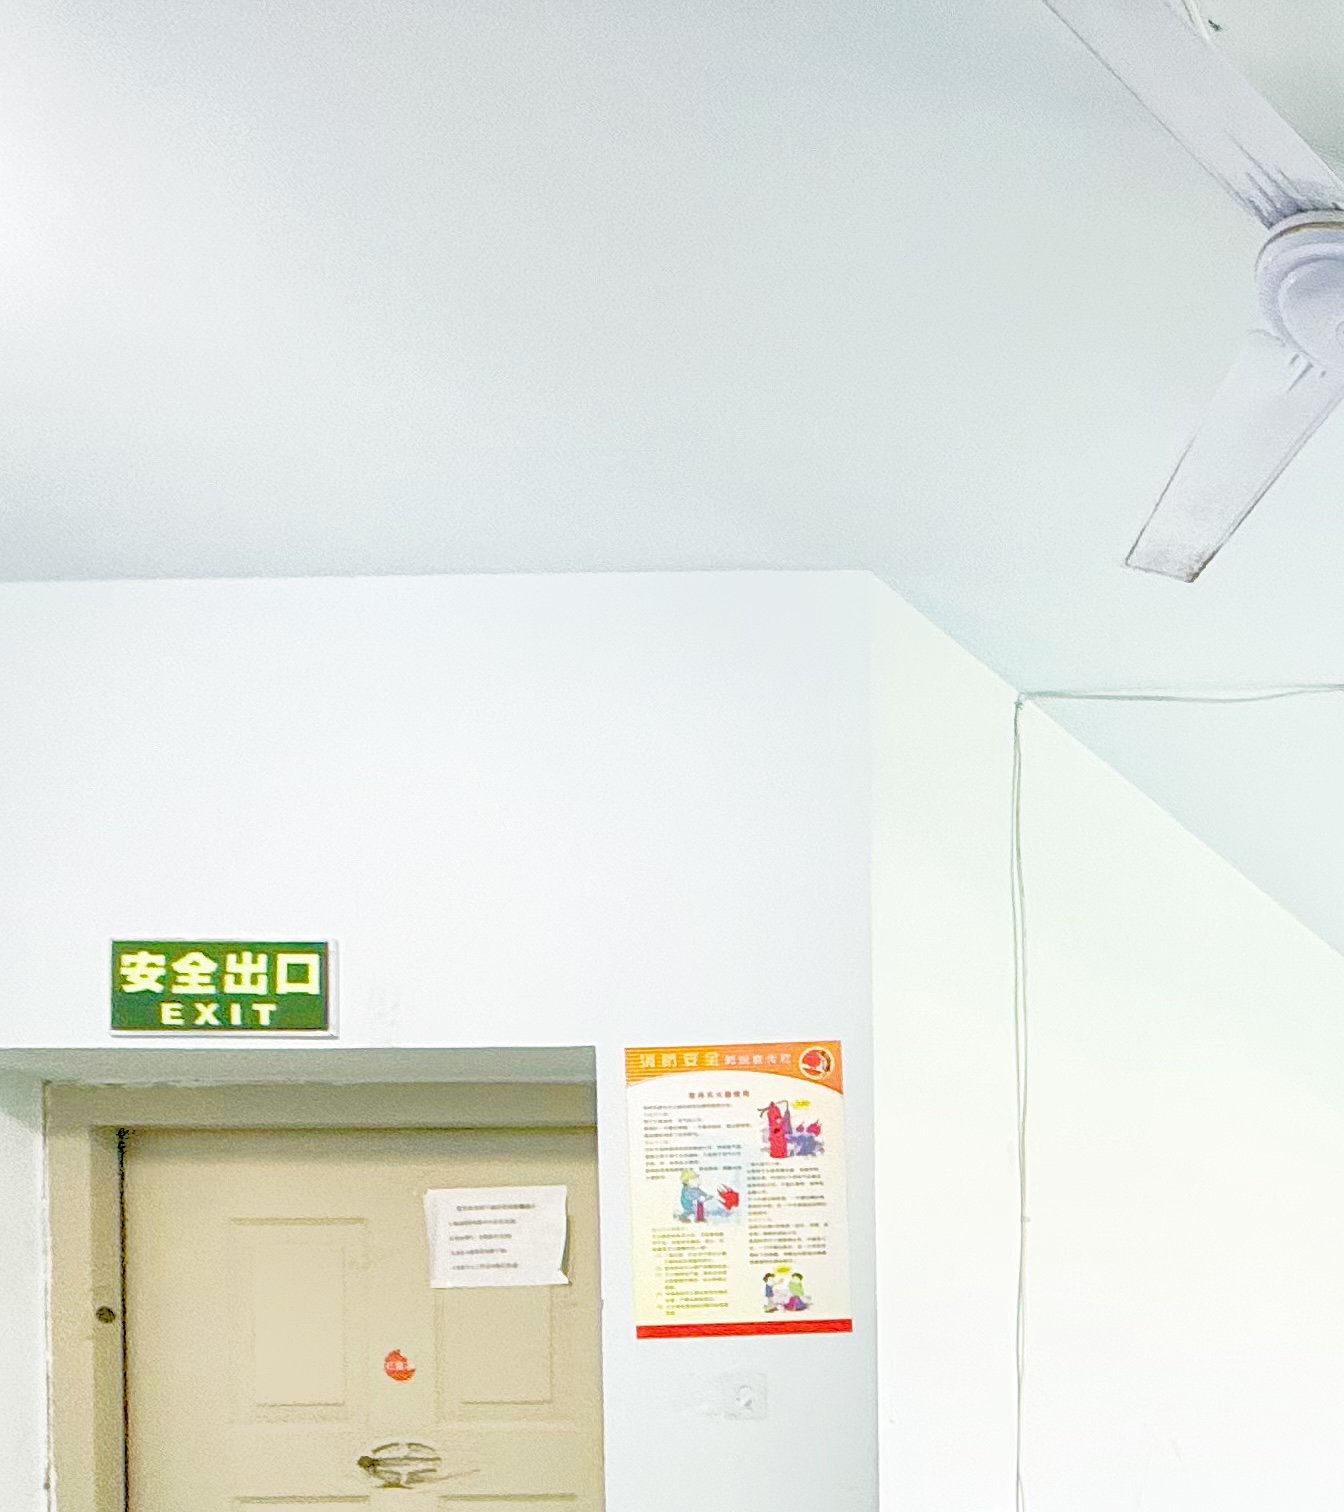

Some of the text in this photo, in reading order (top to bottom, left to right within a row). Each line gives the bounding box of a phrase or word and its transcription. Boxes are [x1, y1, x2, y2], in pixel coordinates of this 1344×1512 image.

[119, 950, 320, 995] 安全出口
[160, 1002, 278, 1026] EXIT
